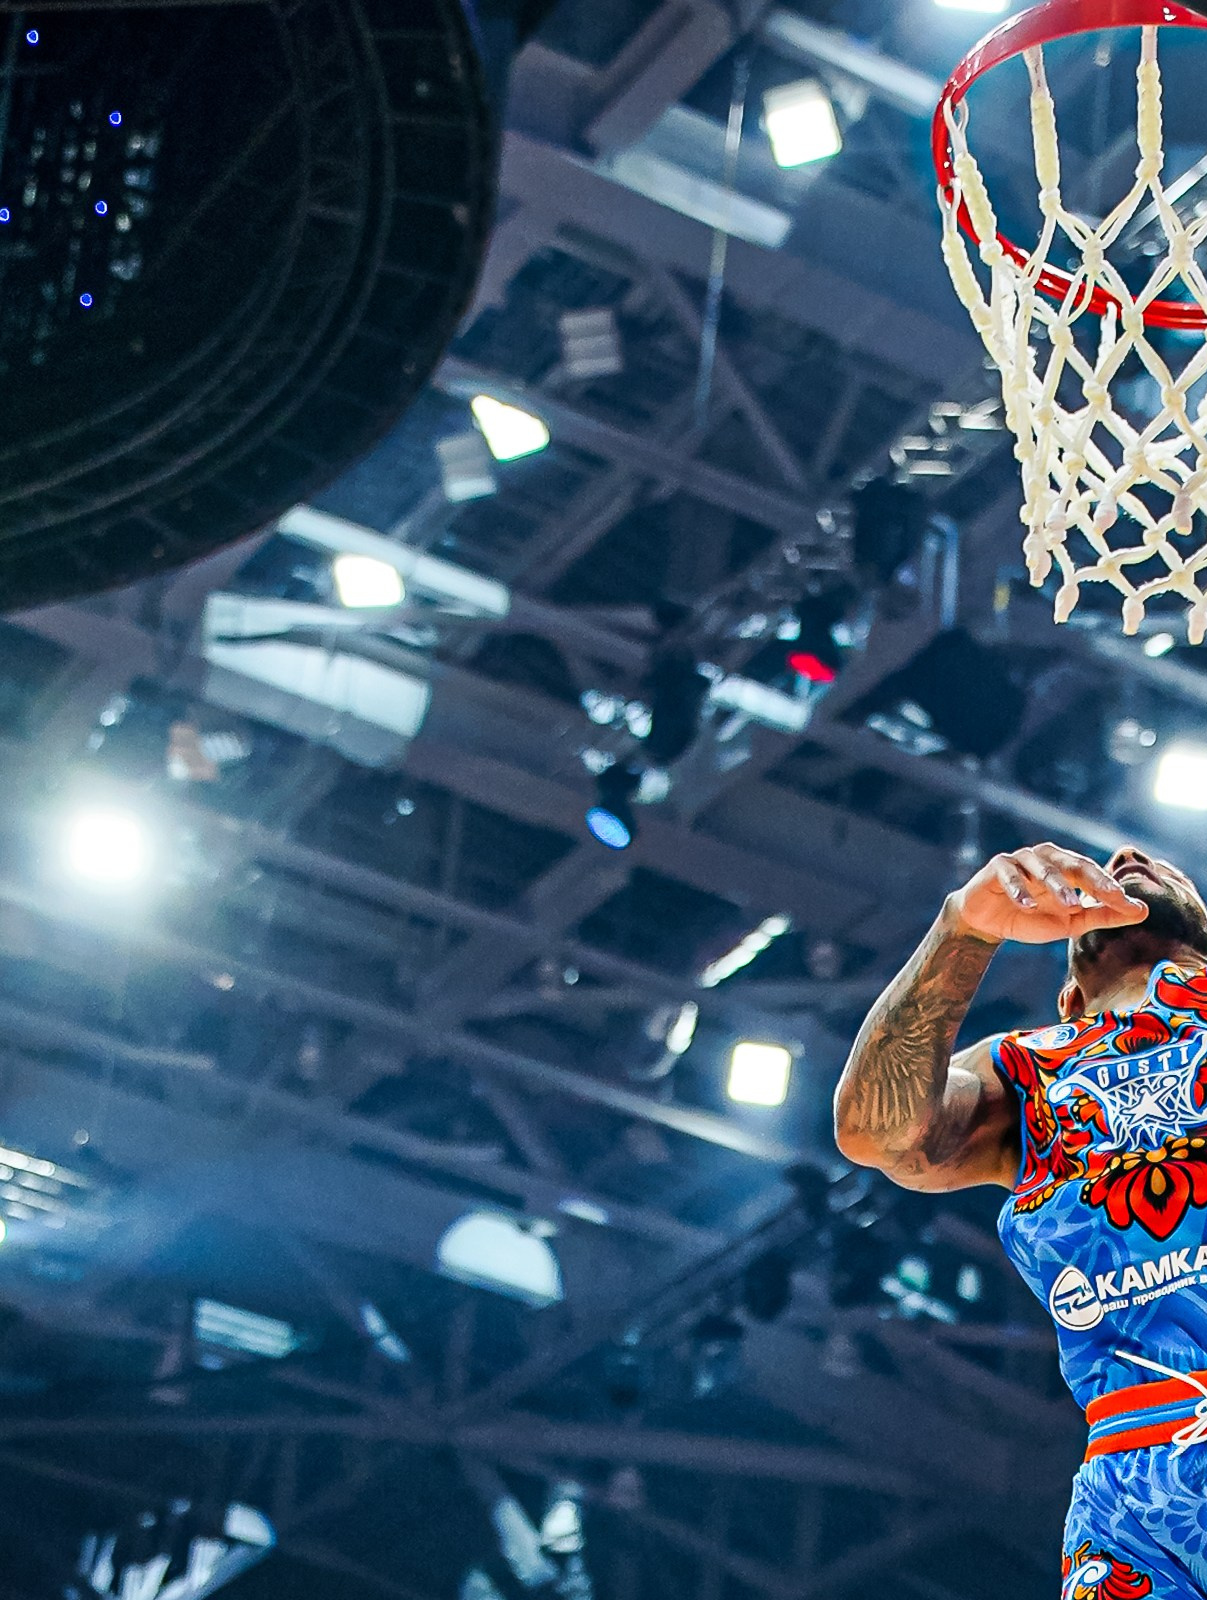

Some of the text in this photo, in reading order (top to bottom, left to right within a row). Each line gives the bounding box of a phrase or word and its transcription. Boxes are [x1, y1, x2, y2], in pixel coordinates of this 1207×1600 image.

[1096, 1046, 1189, 1088] GOSTI
[1132, 1275, 1197, 1306] проводник
[1199, 1273, 1207, 1284] в
